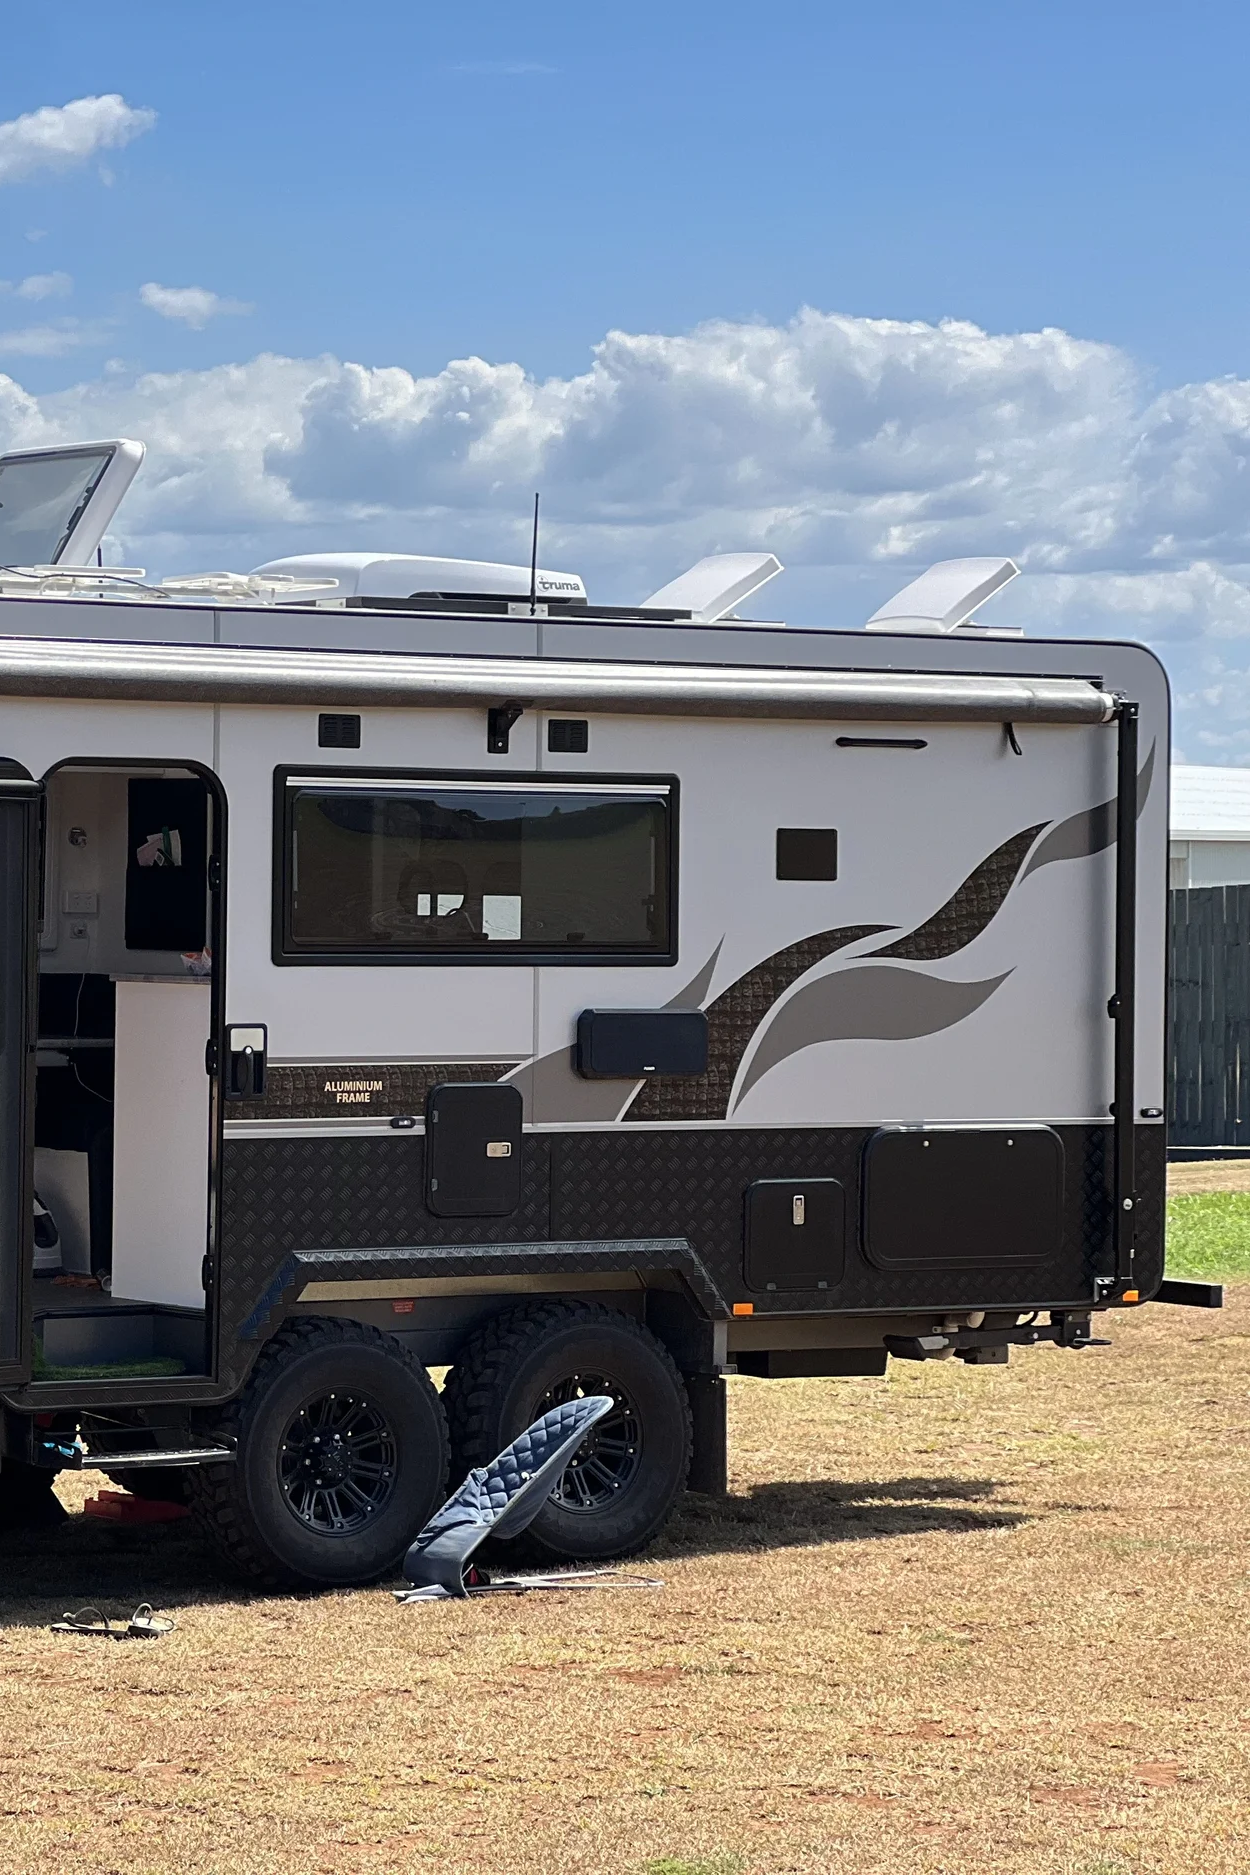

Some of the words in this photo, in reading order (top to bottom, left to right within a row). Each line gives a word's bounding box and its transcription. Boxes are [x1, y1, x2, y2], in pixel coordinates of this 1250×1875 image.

[538, 576, 580, 592] truma
[324, 1081, 383, 1092] ALUMINIUM
[336, 1092, 371, 1103] FRAME
